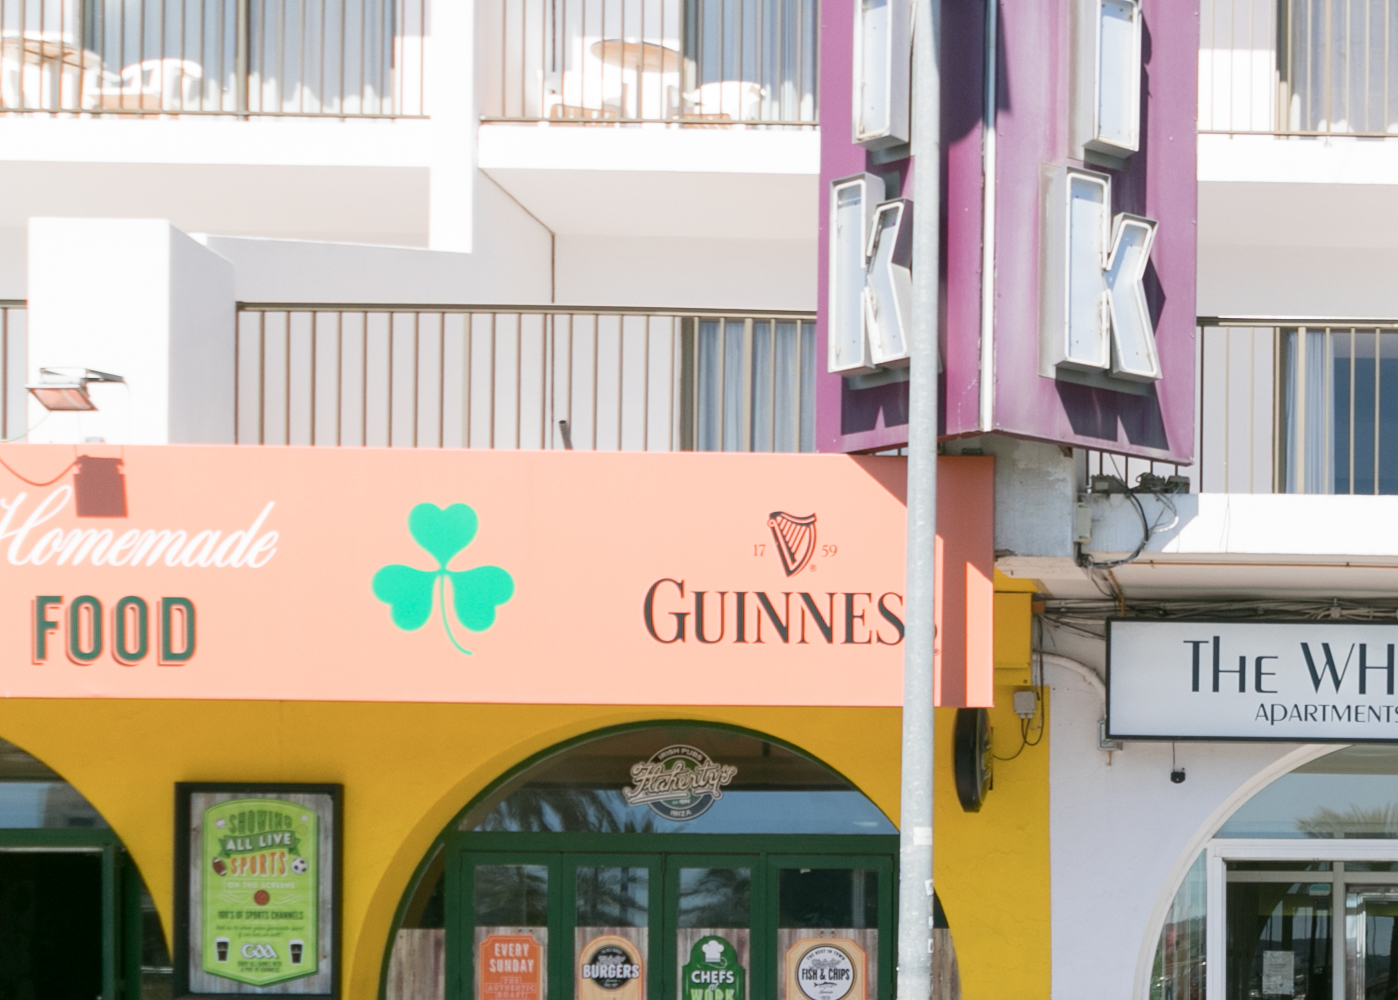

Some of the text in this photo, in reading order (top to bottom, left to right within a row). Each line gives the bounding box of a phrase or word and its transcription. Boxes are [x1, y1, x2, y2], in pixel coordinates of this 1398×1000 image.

[0, 485, 279, 569] Homemade
[752, 544, 838, 557] 17 59
[643, 577, 938, 646] GUINNES
[31, 594, 197, 667] FOOD
[658, 748, 703, 761] IRISH PUBS
[229, 810, 293, 835] SHOWING
[226, 832, 292, 851] ALL LIVE
[230, 851, 288, 876] SPORTS
[245, 911, 270, 920] SPORTS
[494, 943, 529, 958] EVERY
[489, 959, 535, 974] SUNDAY
[582, 963, 640, 979] BURGERS
[691, 970, 735, 984] CHEFS
[802, 968, 850, 981] FISH & CHIPS
[497, 992, 525, 1000] ROAST
